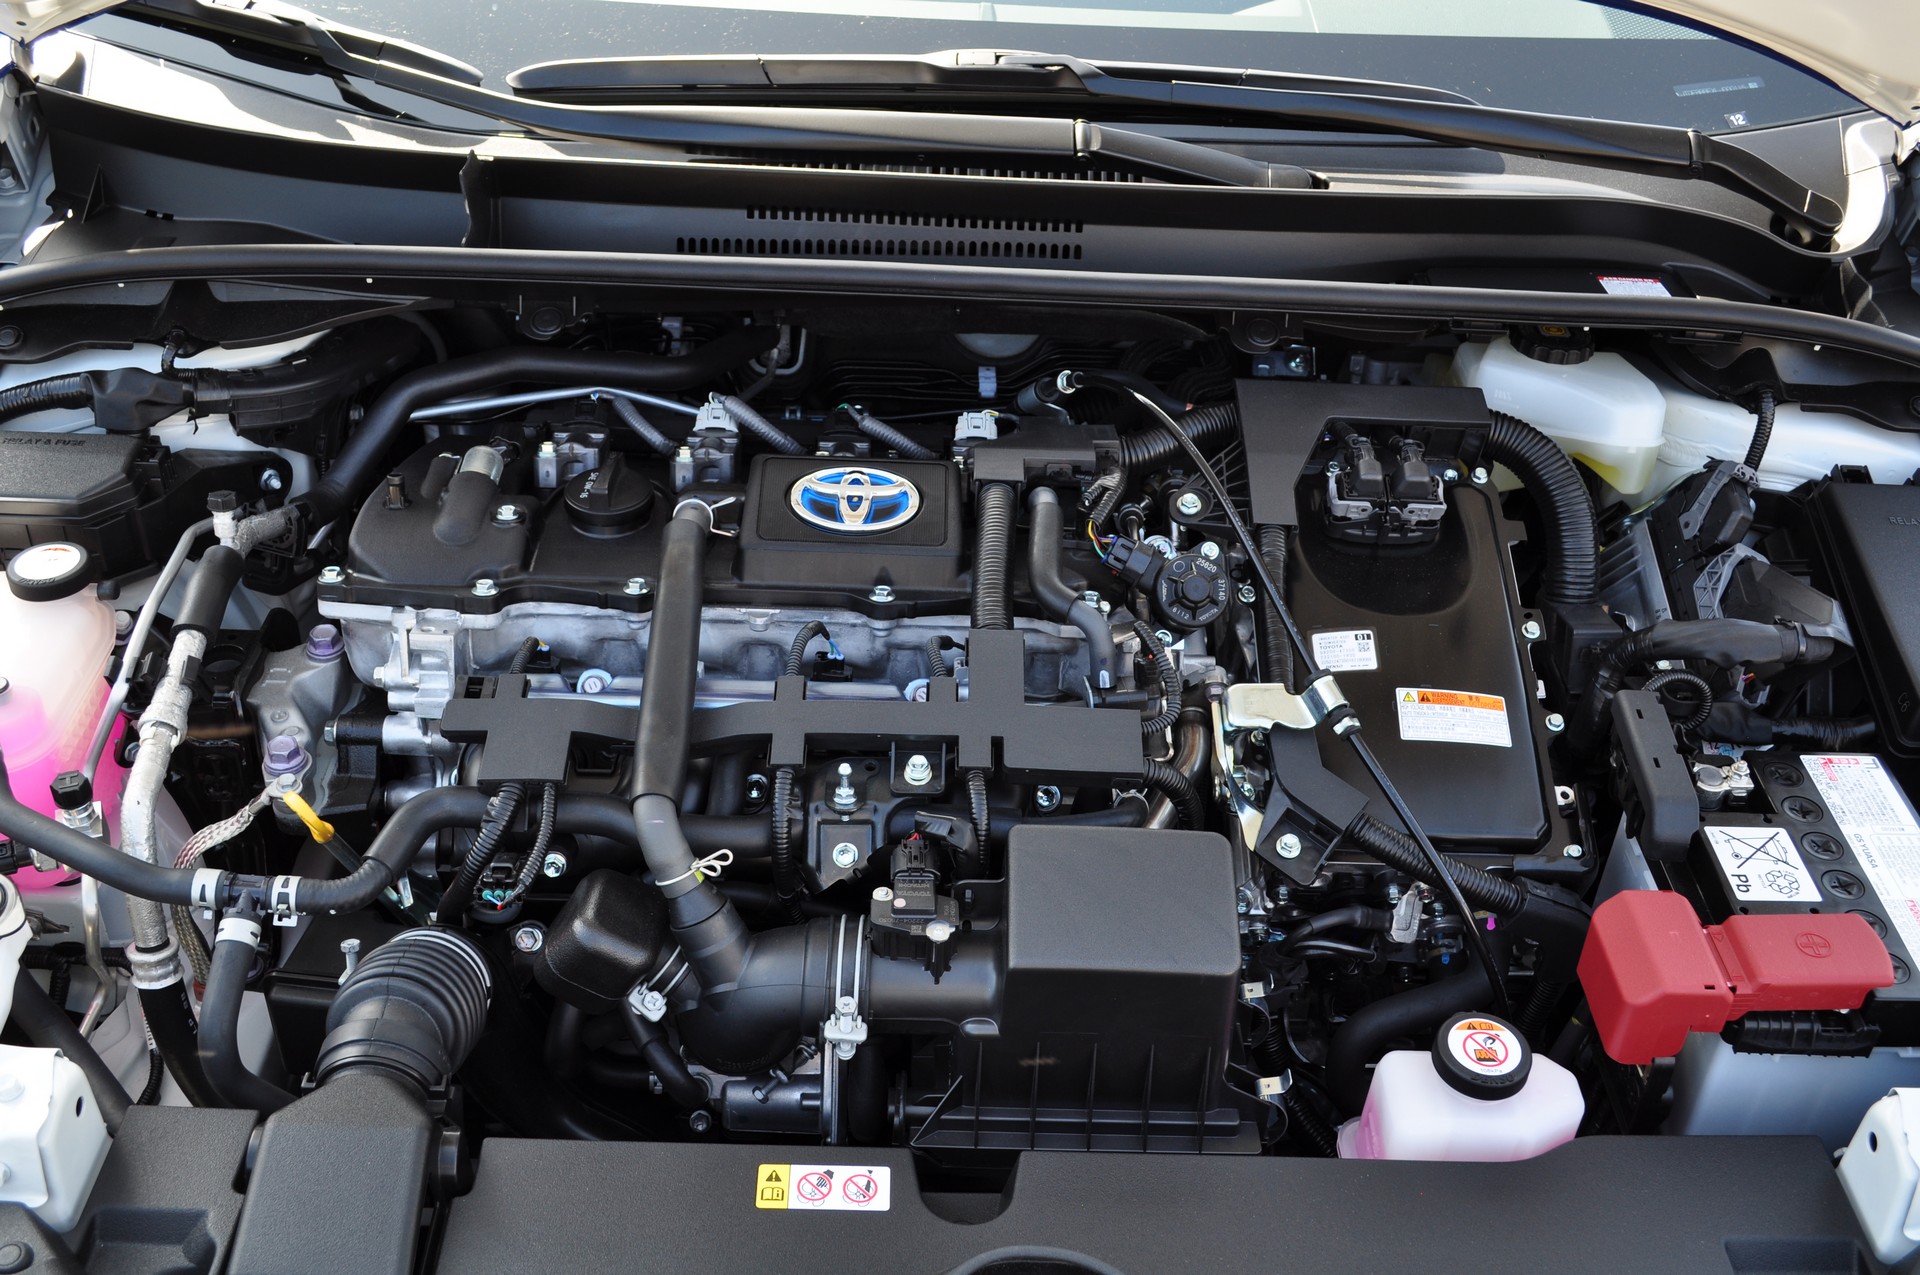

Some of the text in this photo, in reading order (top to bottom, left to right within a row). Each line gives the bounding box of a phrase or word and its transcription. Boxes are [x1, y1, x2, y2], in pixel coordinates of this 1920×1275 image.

[1730, 114, 1746, 126] 12
[1196, 558, 1217, 573] 25620
[1218, 579, 1226, 600] 37140
[1199, 608, 1218, 621] TOYOTA
[1853, 833, 1864, 843] GS
[1861, 843, 1878, 869] YUASA
[1731, 874, 1752, 893] Pb
